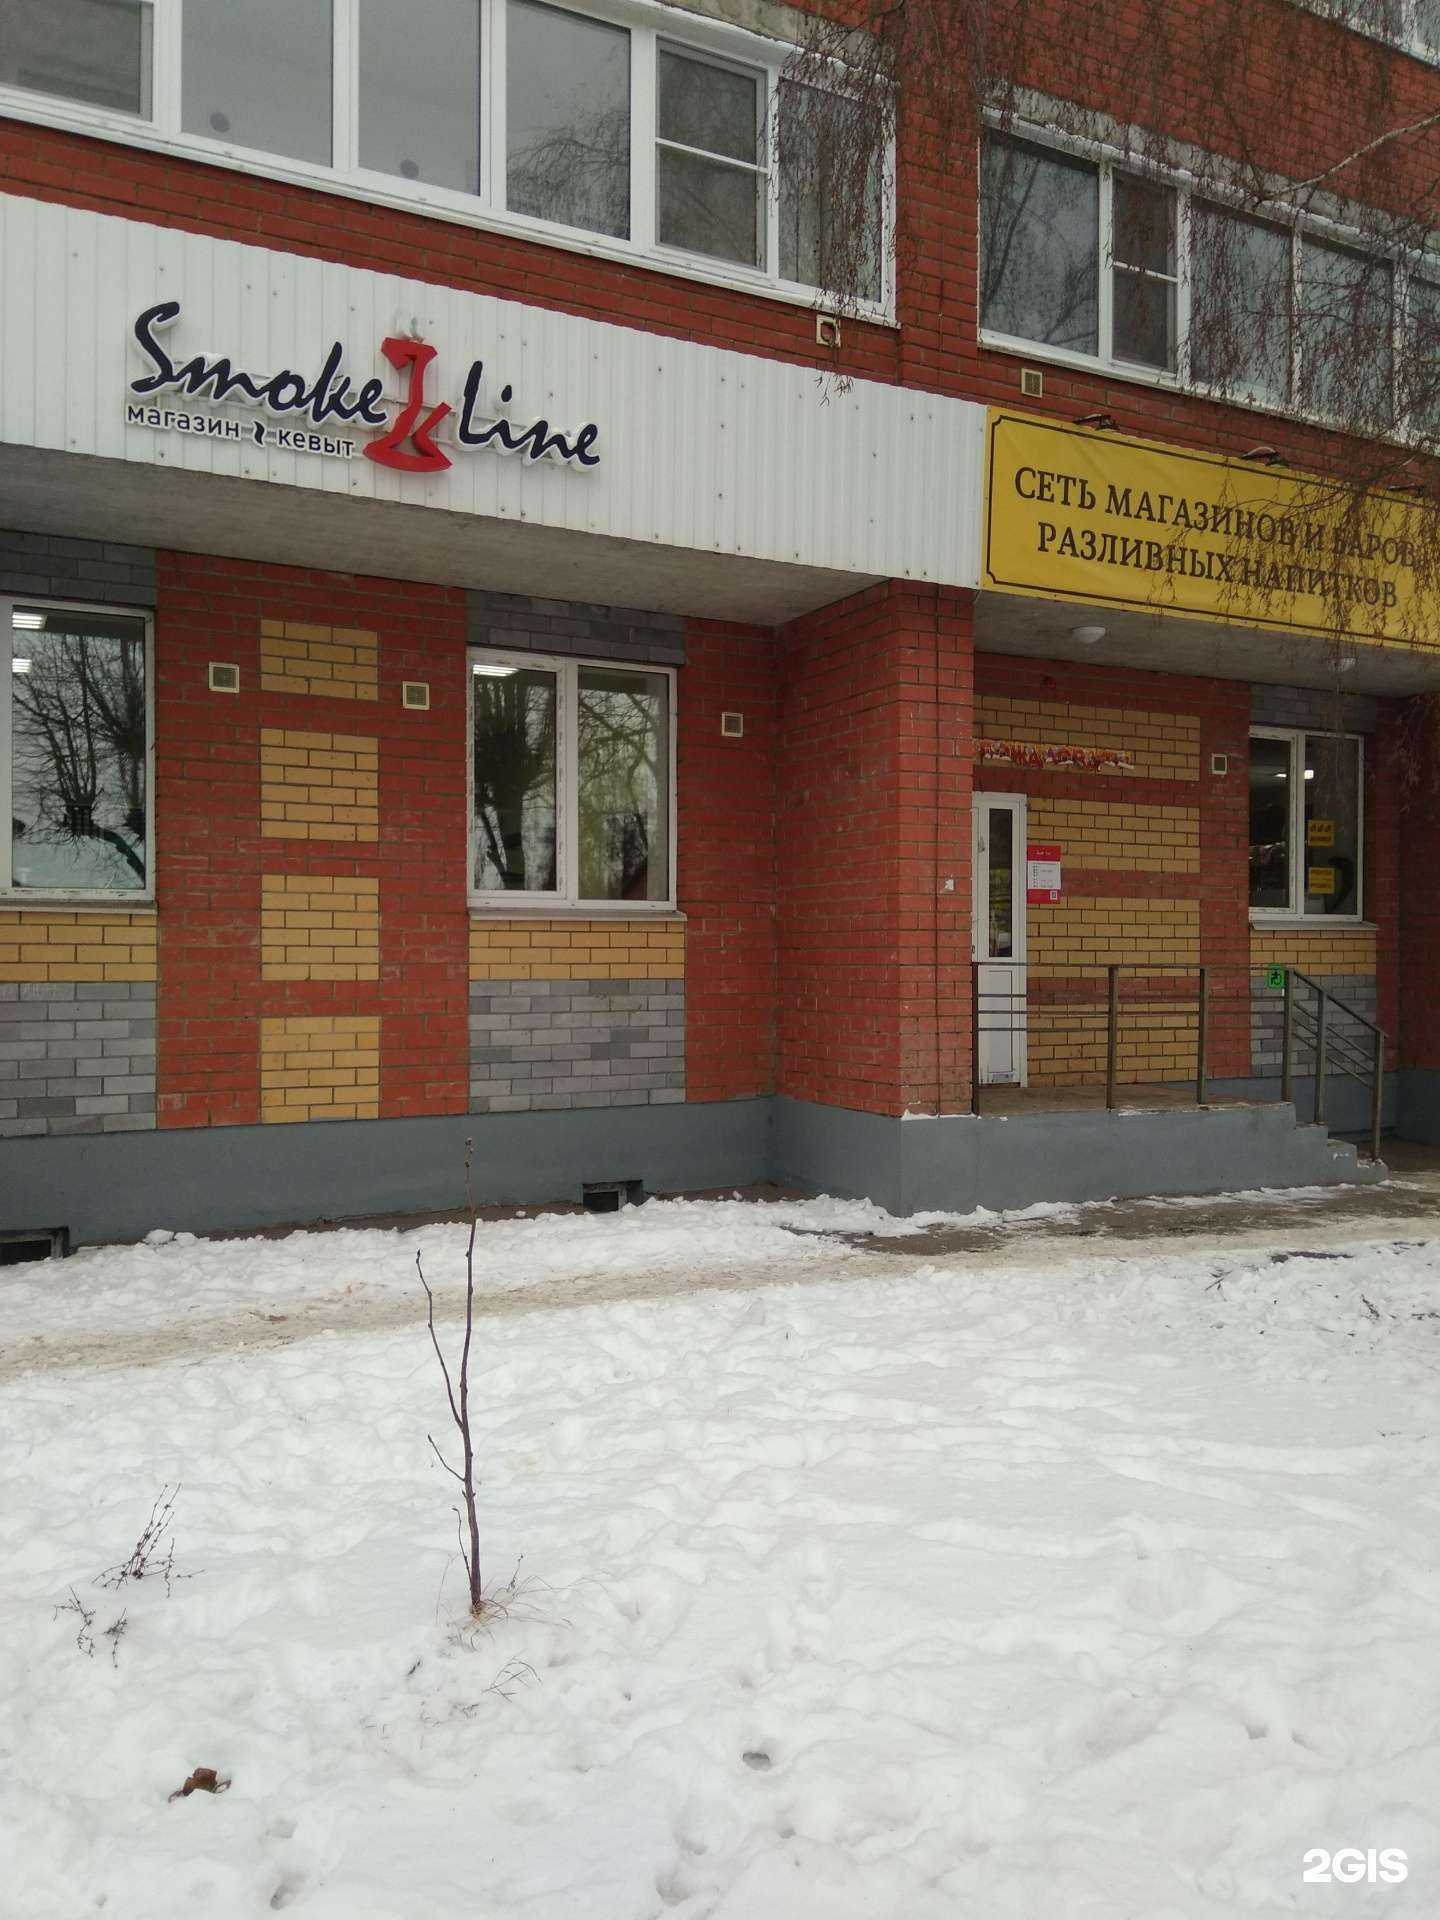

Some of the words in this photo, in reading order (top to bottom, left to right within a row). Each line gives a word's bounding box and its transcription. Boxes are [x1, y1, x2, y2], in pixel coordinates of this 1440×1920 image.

[130, 301, 388, 425] Smoke
[458, 360, 601, 466] Line
[127, 405, 240, 438] магазин
[277, 429, 354, 457] кевыт
[1014, 466, 1097, 511] СЕТЬ
[1105, 484, 1297, 546] МАГАЗИНОВ
[1303, 522, 1326, 551] И
[1038, 522, 1234, 583] РАЗЛИВНЫХ
[1240, 556, 1397, 608] НАПИТКОВ
